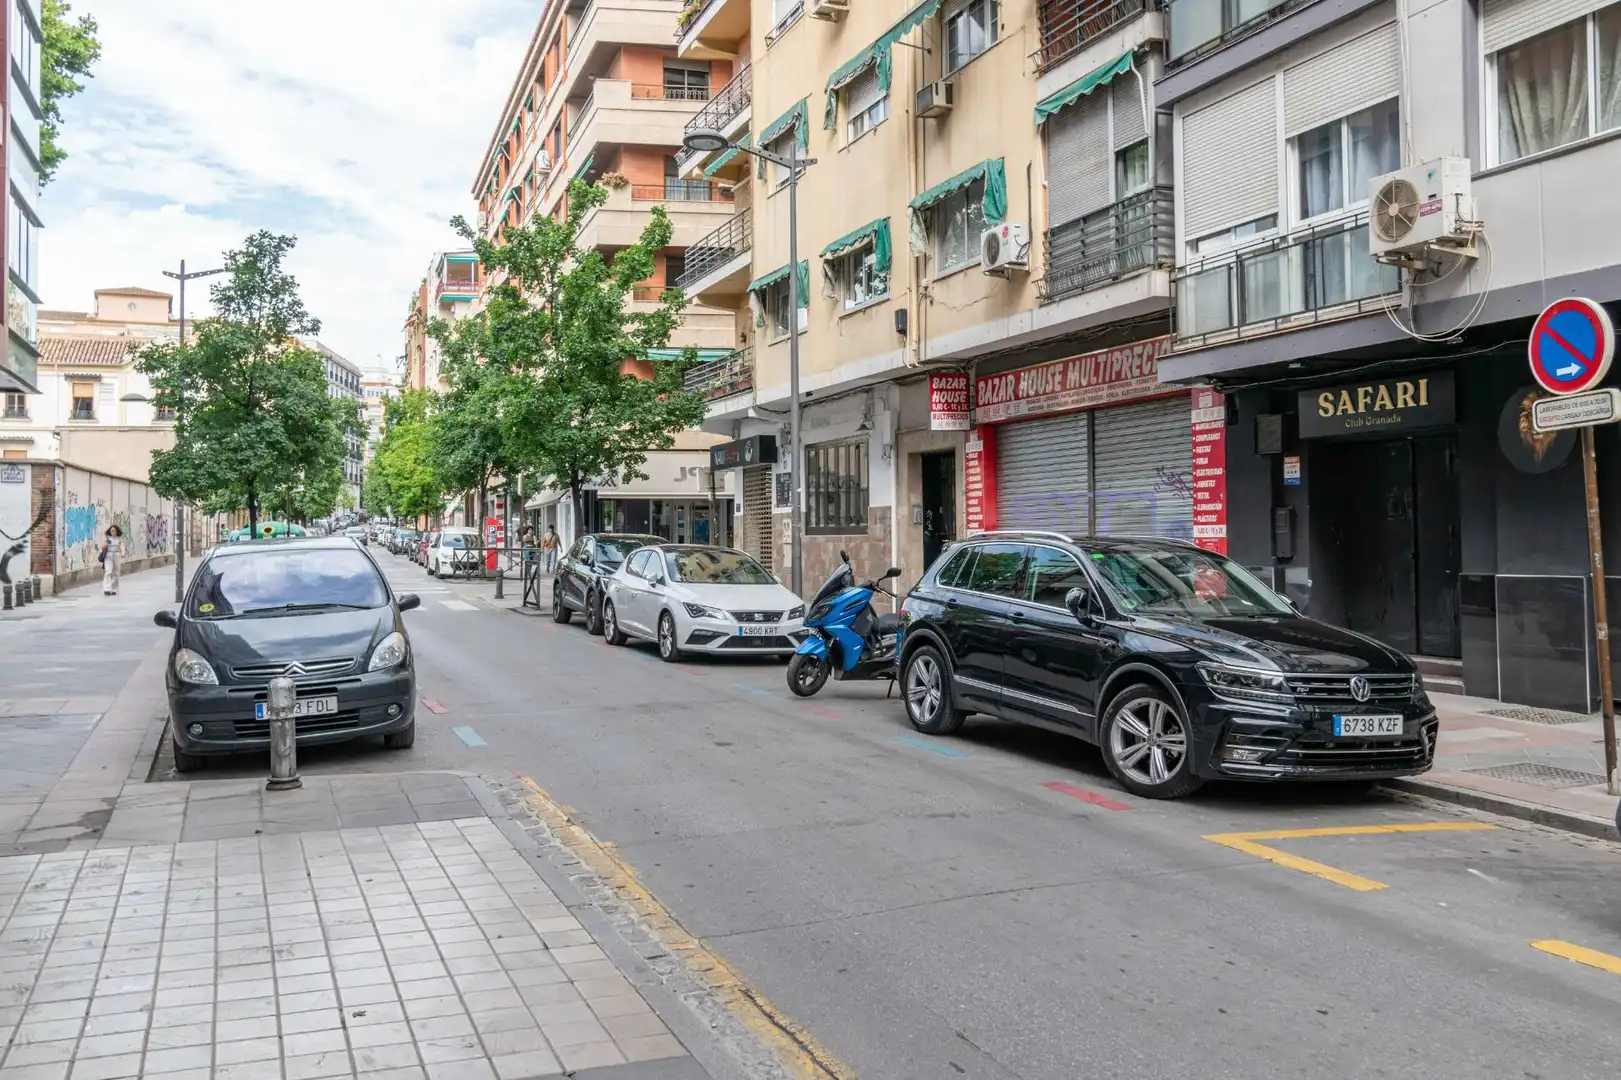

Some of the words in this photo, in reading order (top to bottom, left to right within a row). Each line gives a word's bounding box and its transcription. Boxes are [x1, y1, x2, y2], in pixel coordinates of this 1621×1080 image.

[932, 377, 967, 390] BAZAR
[978, 374, 1015, 406] BAZAR
[1018, 363, 1064, 398] HOUSE
[931, 390, 968, 403] HOUSE
[1318, 378, 1429, 417] SAFARI
[1540, 403, 1571, 413] LABORABLES
[1540, 414, 1560, 423] EXCEPTO
[1582, 407, 1610, 417] DESCARGA
[932, 413, 969, 421] MULTIPRECIOS
[1345, 417, 1364, 428] Club
[1365, 413, 1401, 426] Granada
[744, 627, 762, 635] 4900
[764, 627, 778, 635] KRT
[307, 699, 334, 714] FDL
[1344, 718, 1375, 733] 6738
[1378, 717, 1400, 732] KZF
